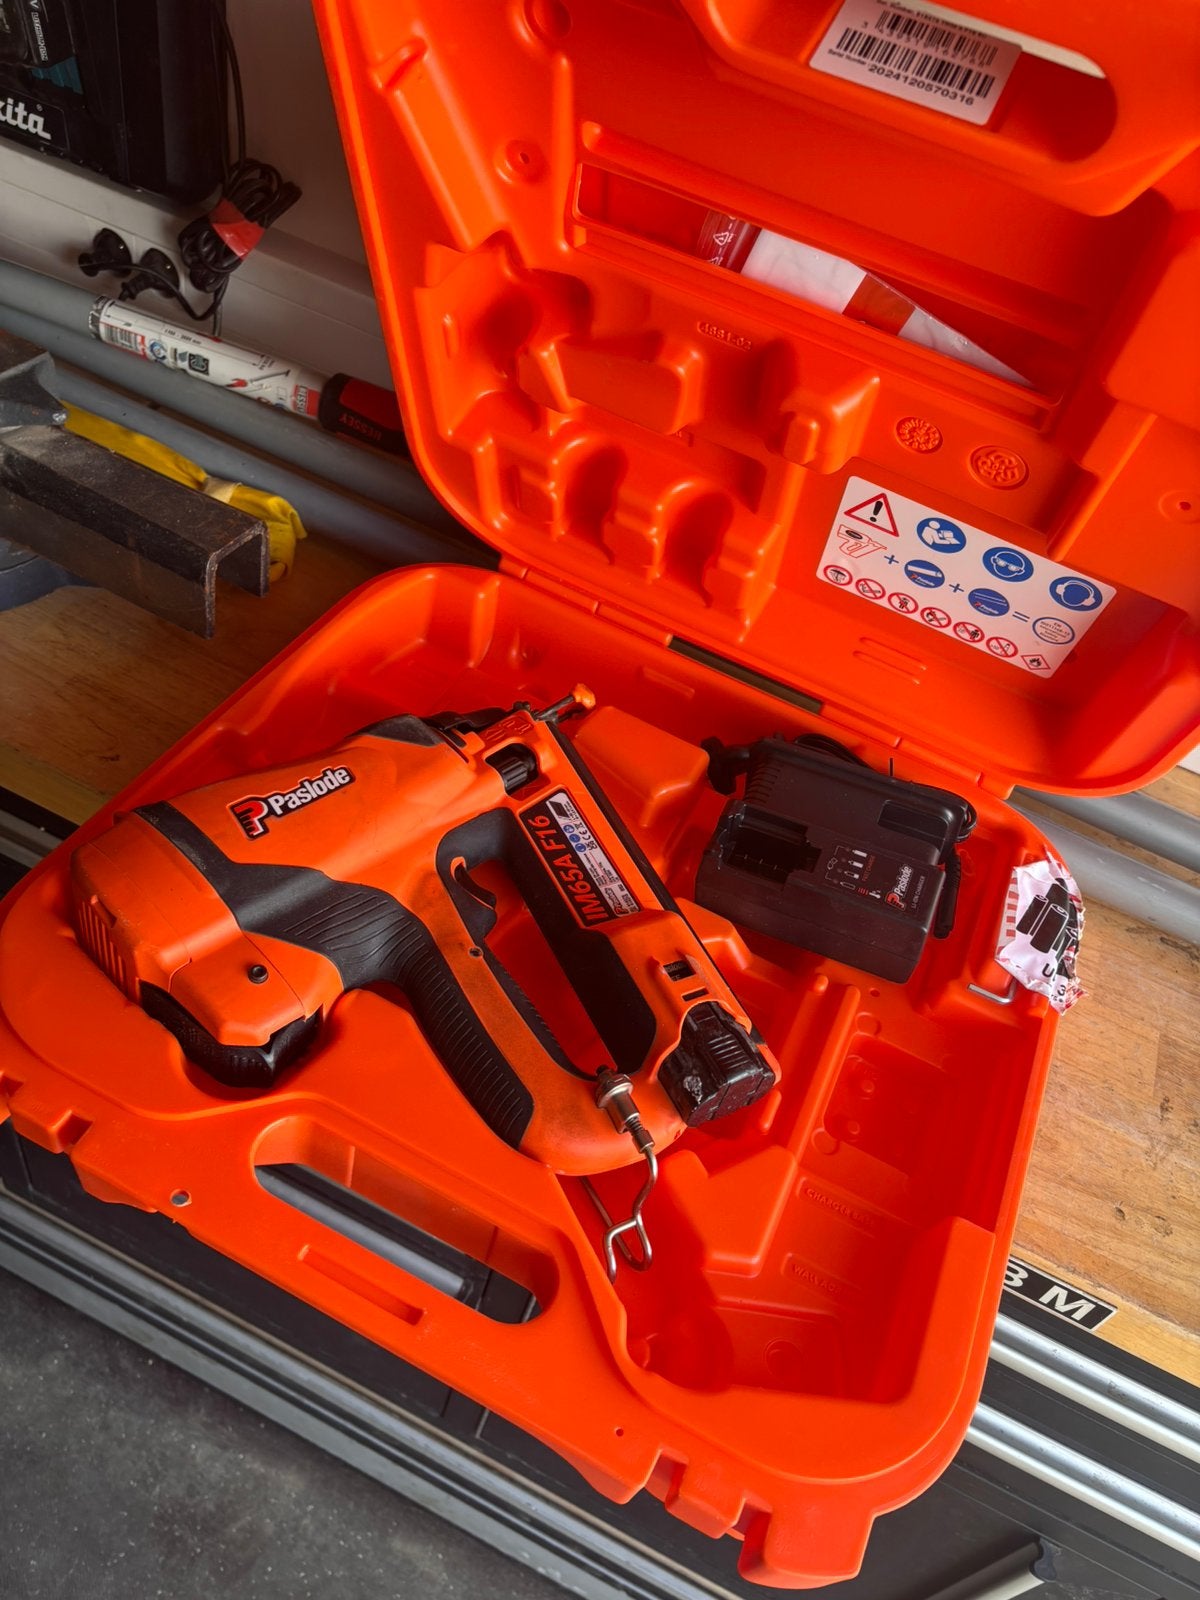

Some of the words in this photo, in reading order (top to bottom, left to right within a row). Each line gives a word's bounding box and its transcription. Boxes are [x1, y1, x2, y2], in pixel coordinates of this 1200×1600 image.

[868, 64, 975, 106] 2024120570316
[267, 768, 351, 816] Paslode
[528, 815, 567, 852] F16
[552, 853, 609, 921] IM65A
[893, 865, 912, 897] Paslode
[1038, 1285, 1096, 1321] M
